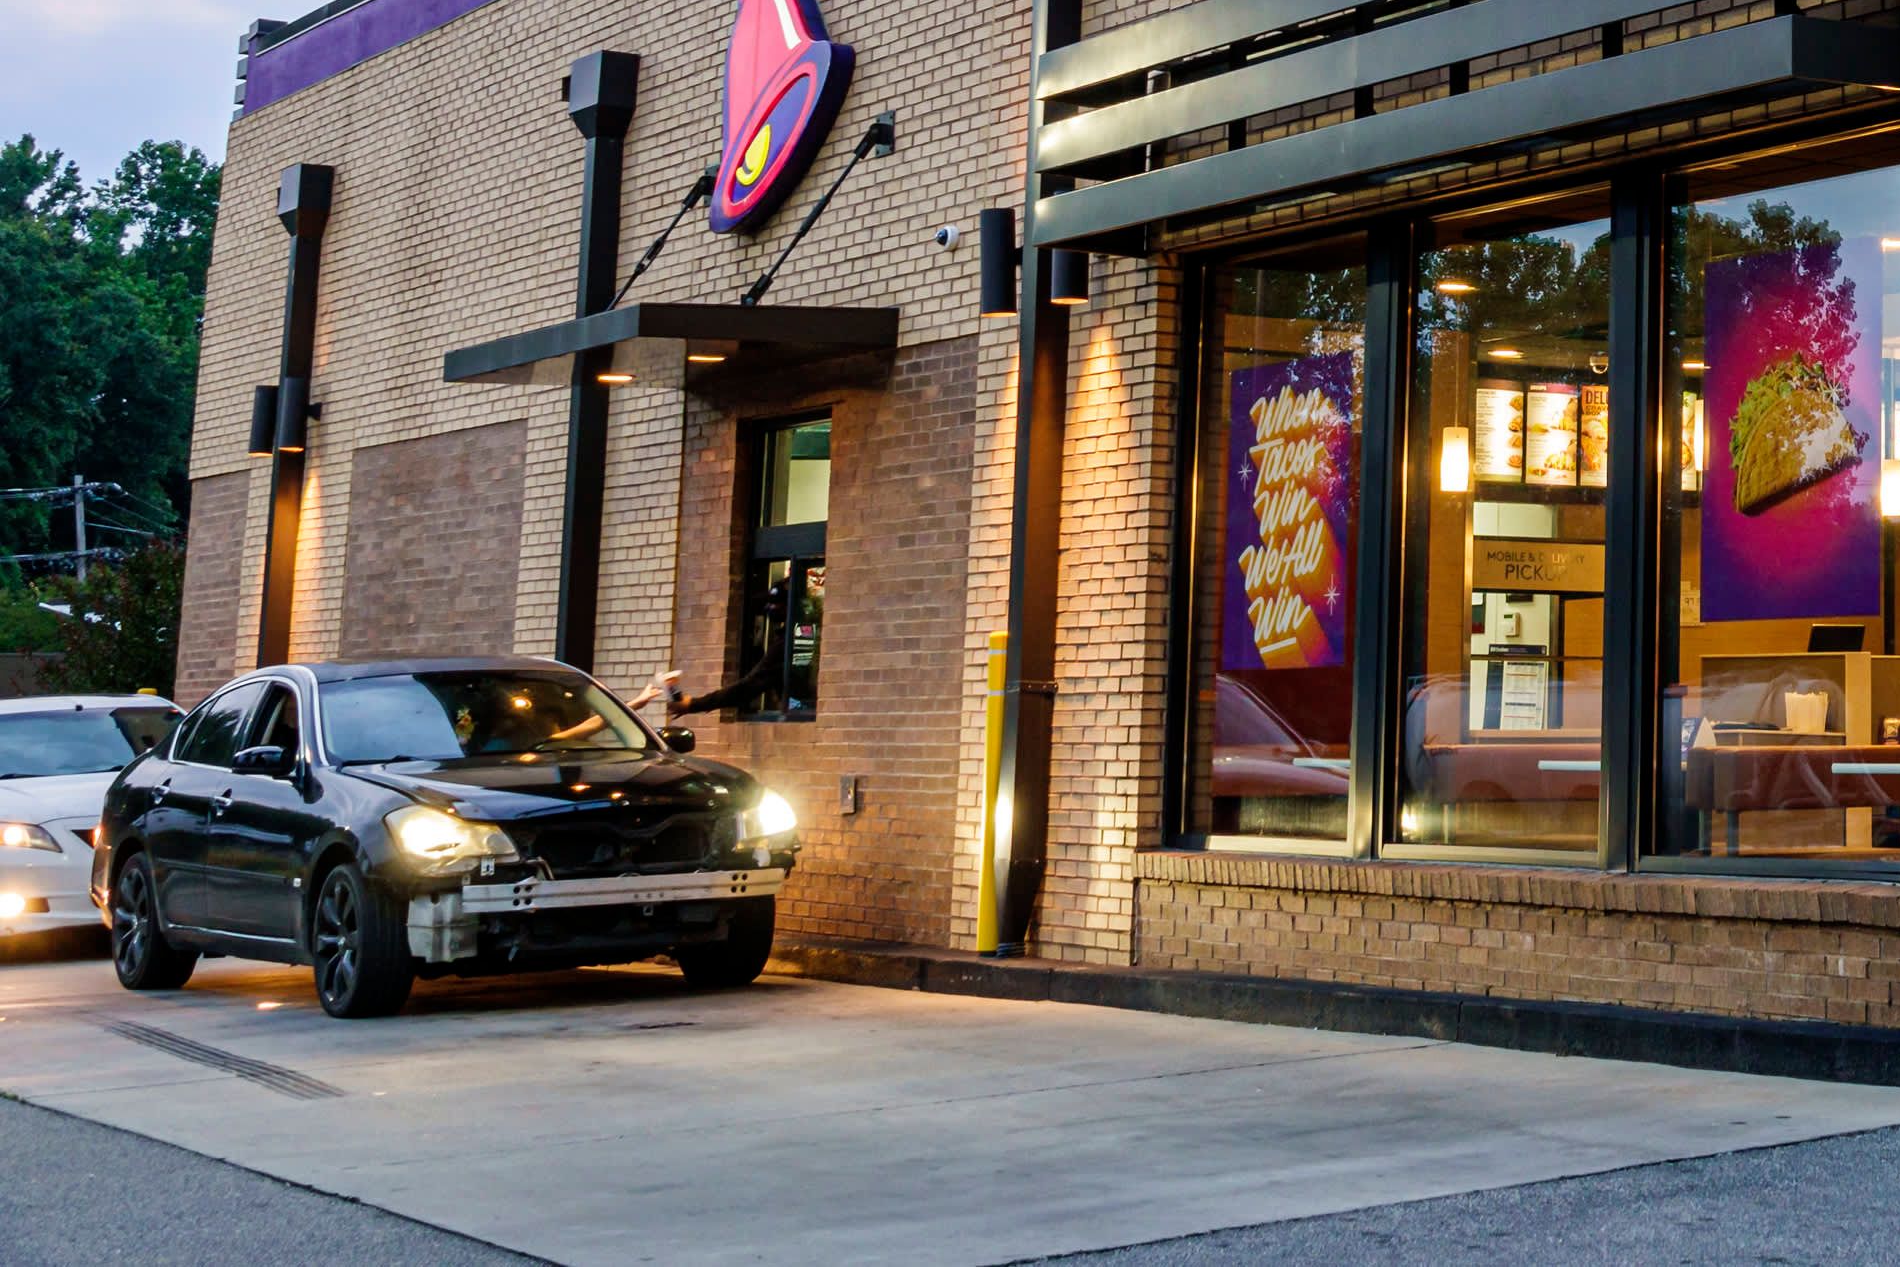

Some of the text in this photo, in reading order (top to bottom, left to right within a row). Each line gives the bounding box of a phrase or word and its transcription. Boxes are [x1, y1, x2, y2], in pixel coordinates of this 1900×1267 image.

[1250, 385, 1332, 440] When
[1249, 434, 1325, 498] Tacos
[1253, 481, 1318, 537] Win
[1238, 518, 1324, 592] We All
[1487, 551, 1527, 563] MOBILE
[1248, 587, 1312, 643] Win
